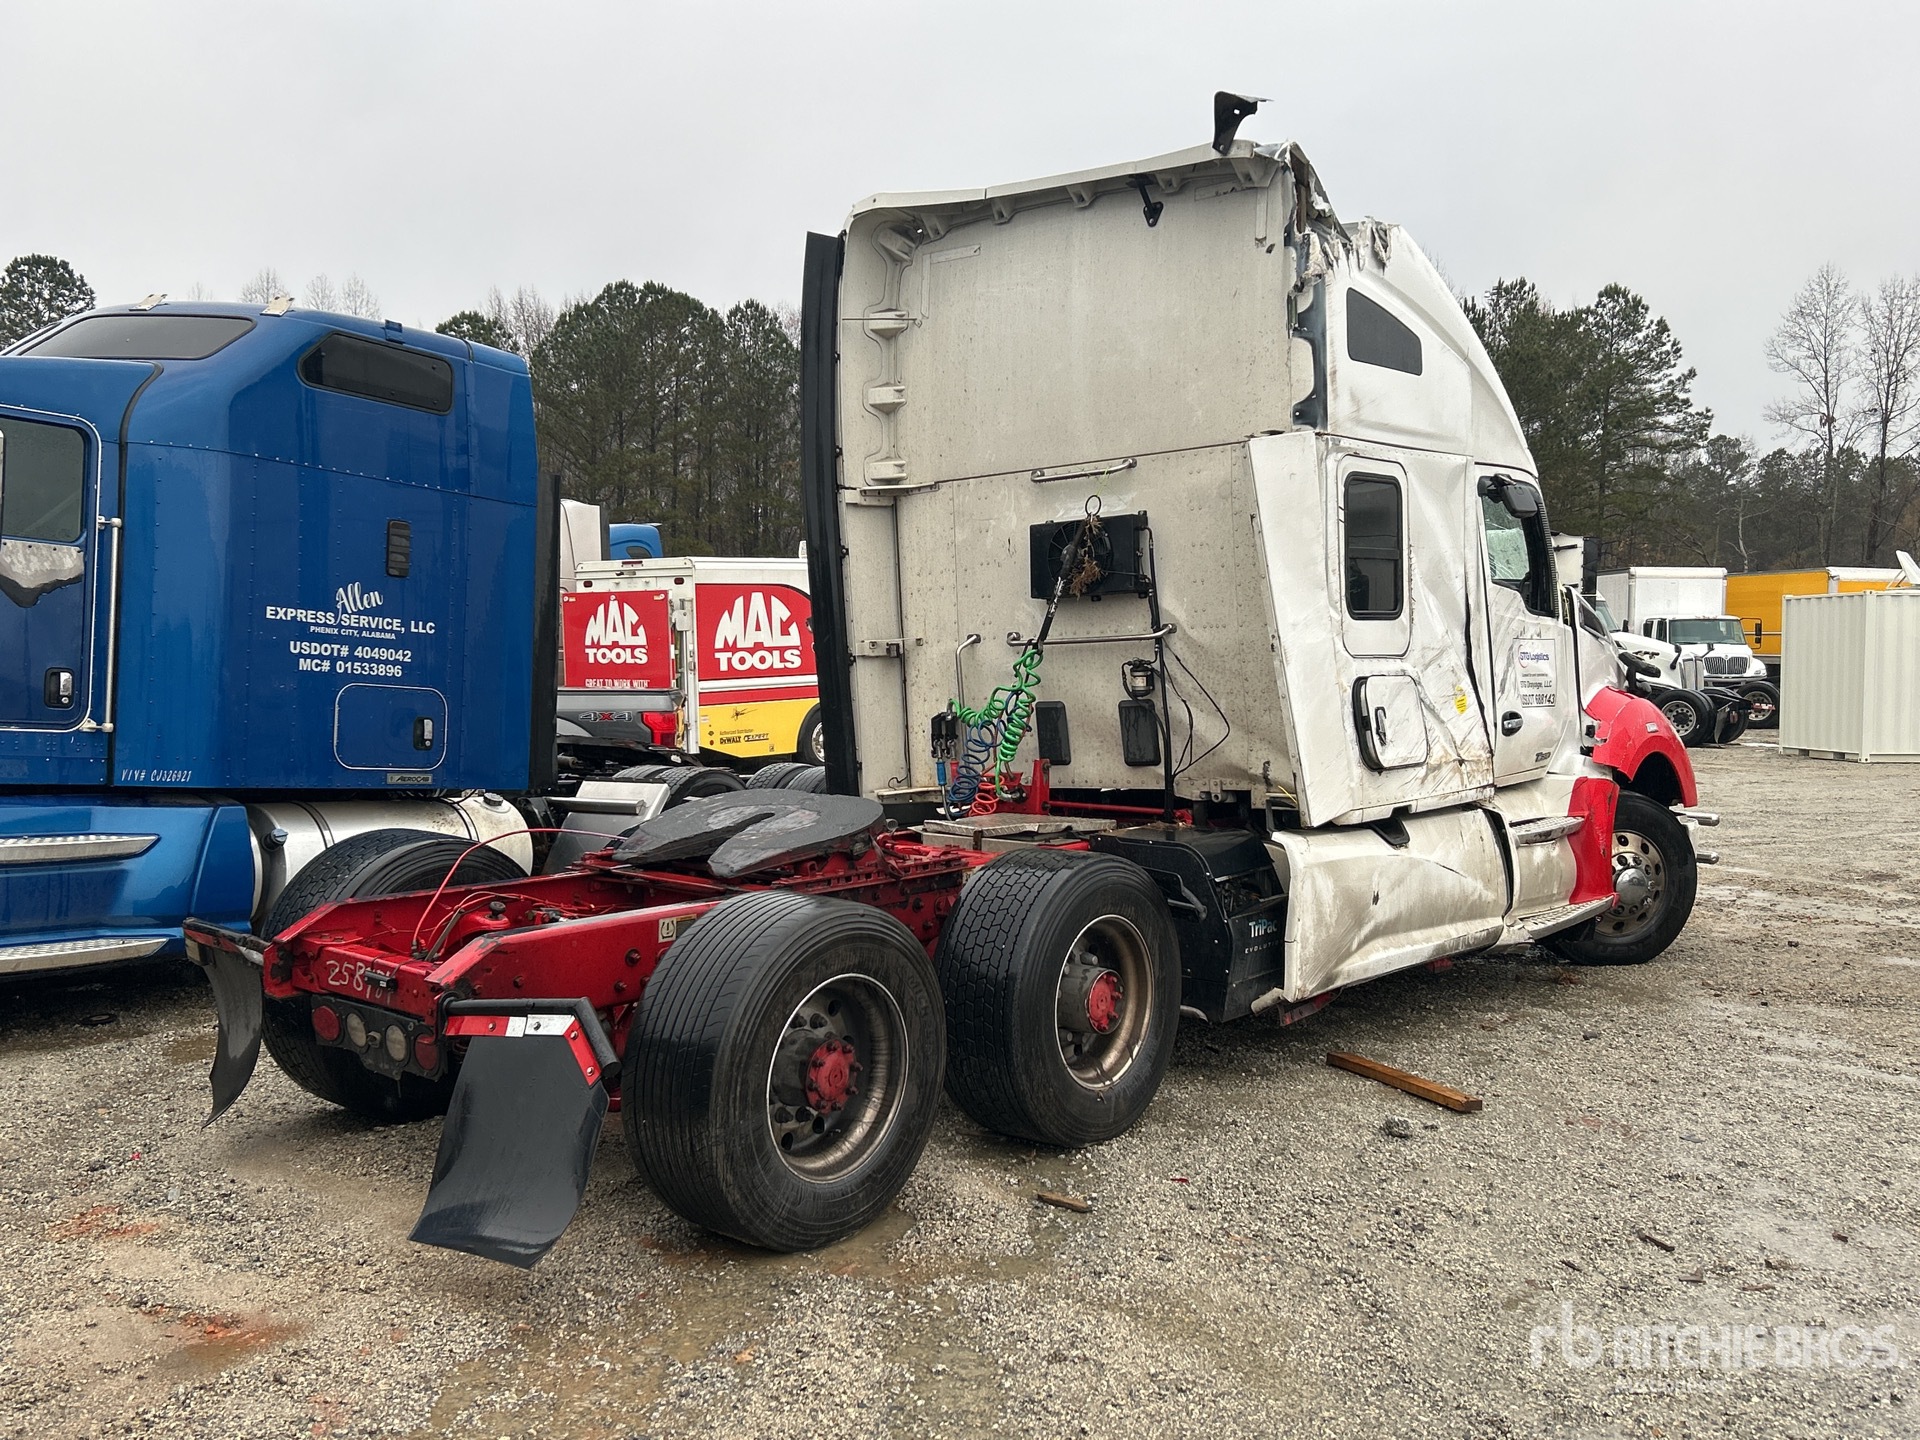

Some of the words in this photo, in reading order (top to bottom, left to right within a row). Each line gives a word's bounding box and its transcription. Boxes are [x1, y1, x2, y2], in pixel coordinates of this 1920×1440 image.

[335, 581, 383, 625] Allen
[265, 606, 336, 625] EXPRESS
[341, 614, 405, 634] SERVICE,
[410, 620, 435, 634] LLC
[585, 600, 647, 645] MAC
[714, 592, 801, 649] MAC
[310, 626, 338, 634] PHENIX
[341, 629, 359, 637] CITY,
[361, 631, 396, 640] ALABAMA
[289, 641, 349, 657] USDOT#
[354, 646, 412, 662] 4049042
[585, 648, 648, 664] TOOLS
[714, 649, 802, 671] TOOLS
[298, 658, 331, 672] MC#
[336, 661, 402, 677] 01533896
[585, 679, 604, 687] GREAT
[605, 680, 612, 688] TO
[614, 680, 631, 688] WORK
[1248, 919, 1278, 938] TriPac
